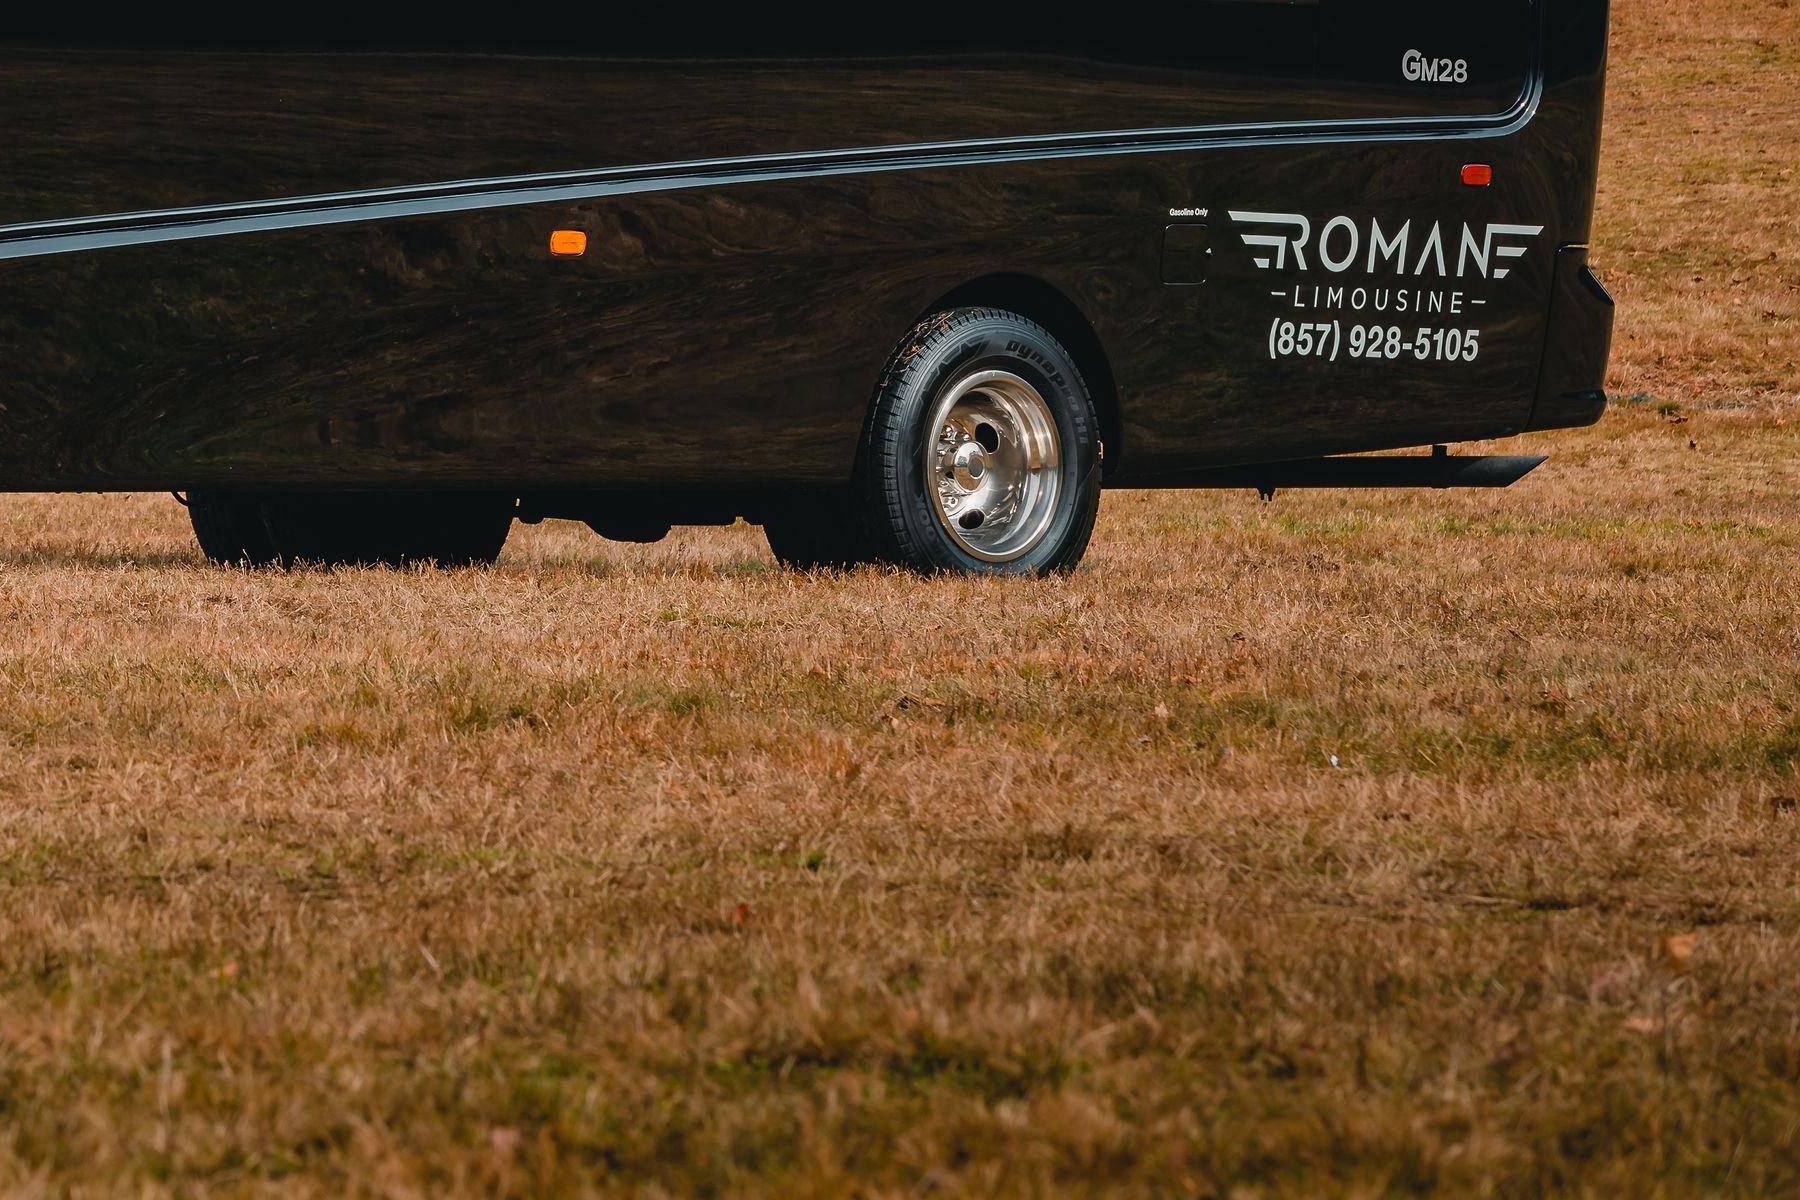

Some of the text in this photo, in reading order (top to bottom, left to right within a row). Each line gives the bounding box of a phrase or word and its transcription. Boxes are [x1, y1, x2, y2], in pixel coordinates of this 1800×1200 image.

[1169, 207, 1209, 217] Gasoline Only
[1227, 210, 1545, 279] ROMAN
[1268, 317, 1480, 362] (857) 928-5105
